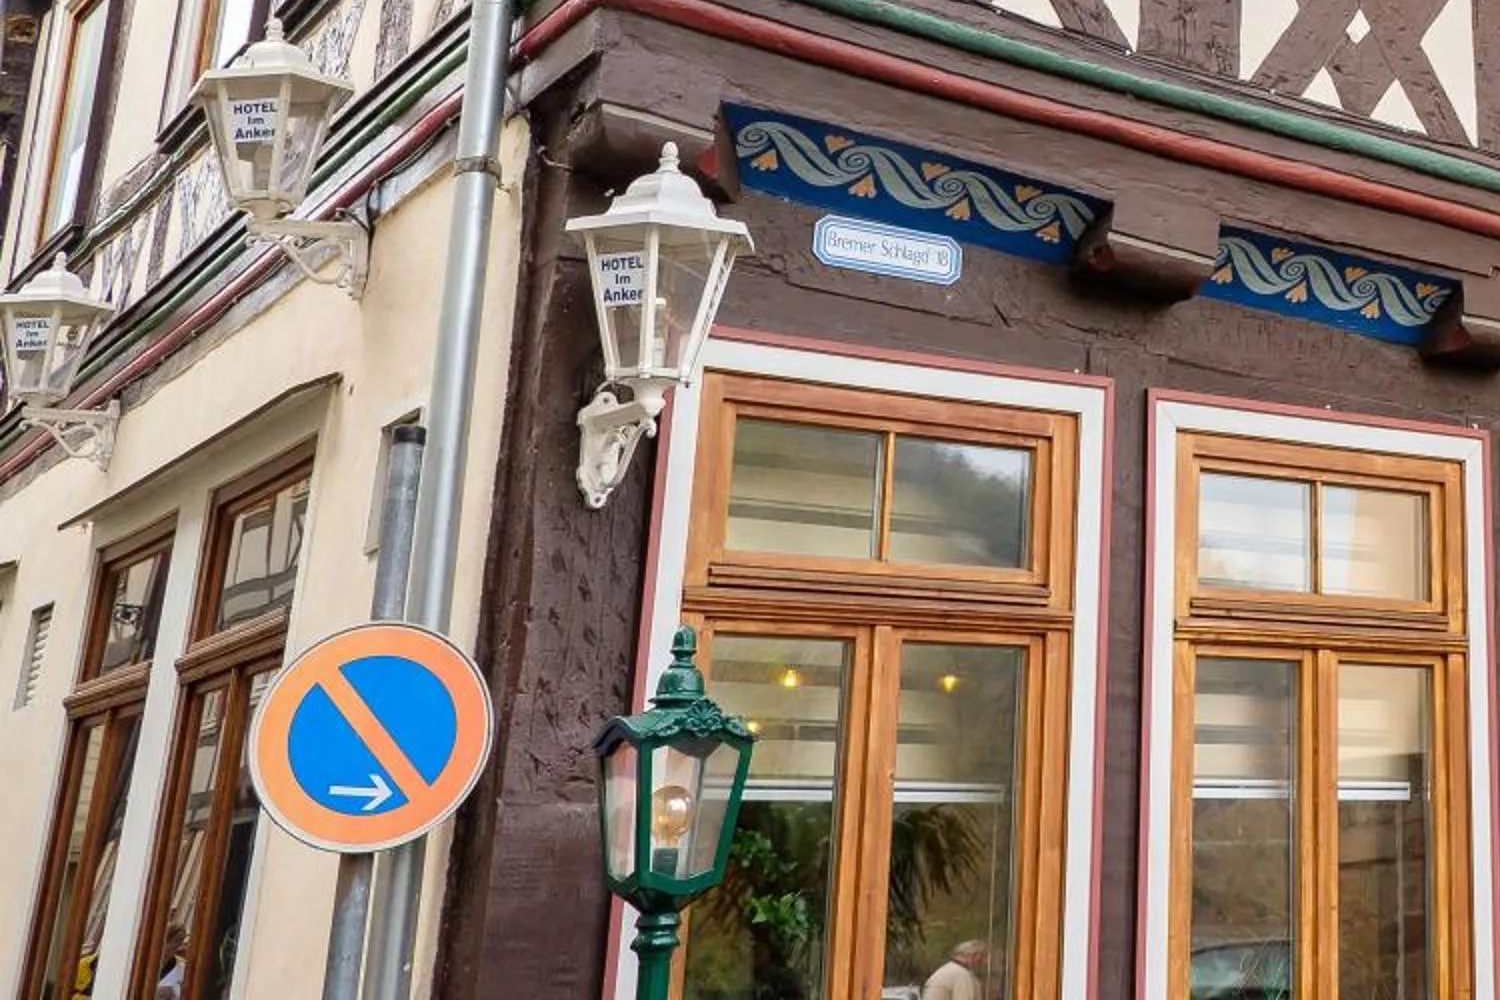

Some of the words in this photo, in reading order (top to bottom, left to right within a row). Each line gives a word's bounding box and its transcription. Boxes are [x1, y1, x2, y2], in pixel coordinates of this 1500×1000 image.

[233, 102, 278, 114] HOTEL
[234, 128, 276, 140] Anker
[601, 256, 644, 271] HOTEL
[615, 274, 631, 284] Im
[603, 287, 643, 302] Anker
